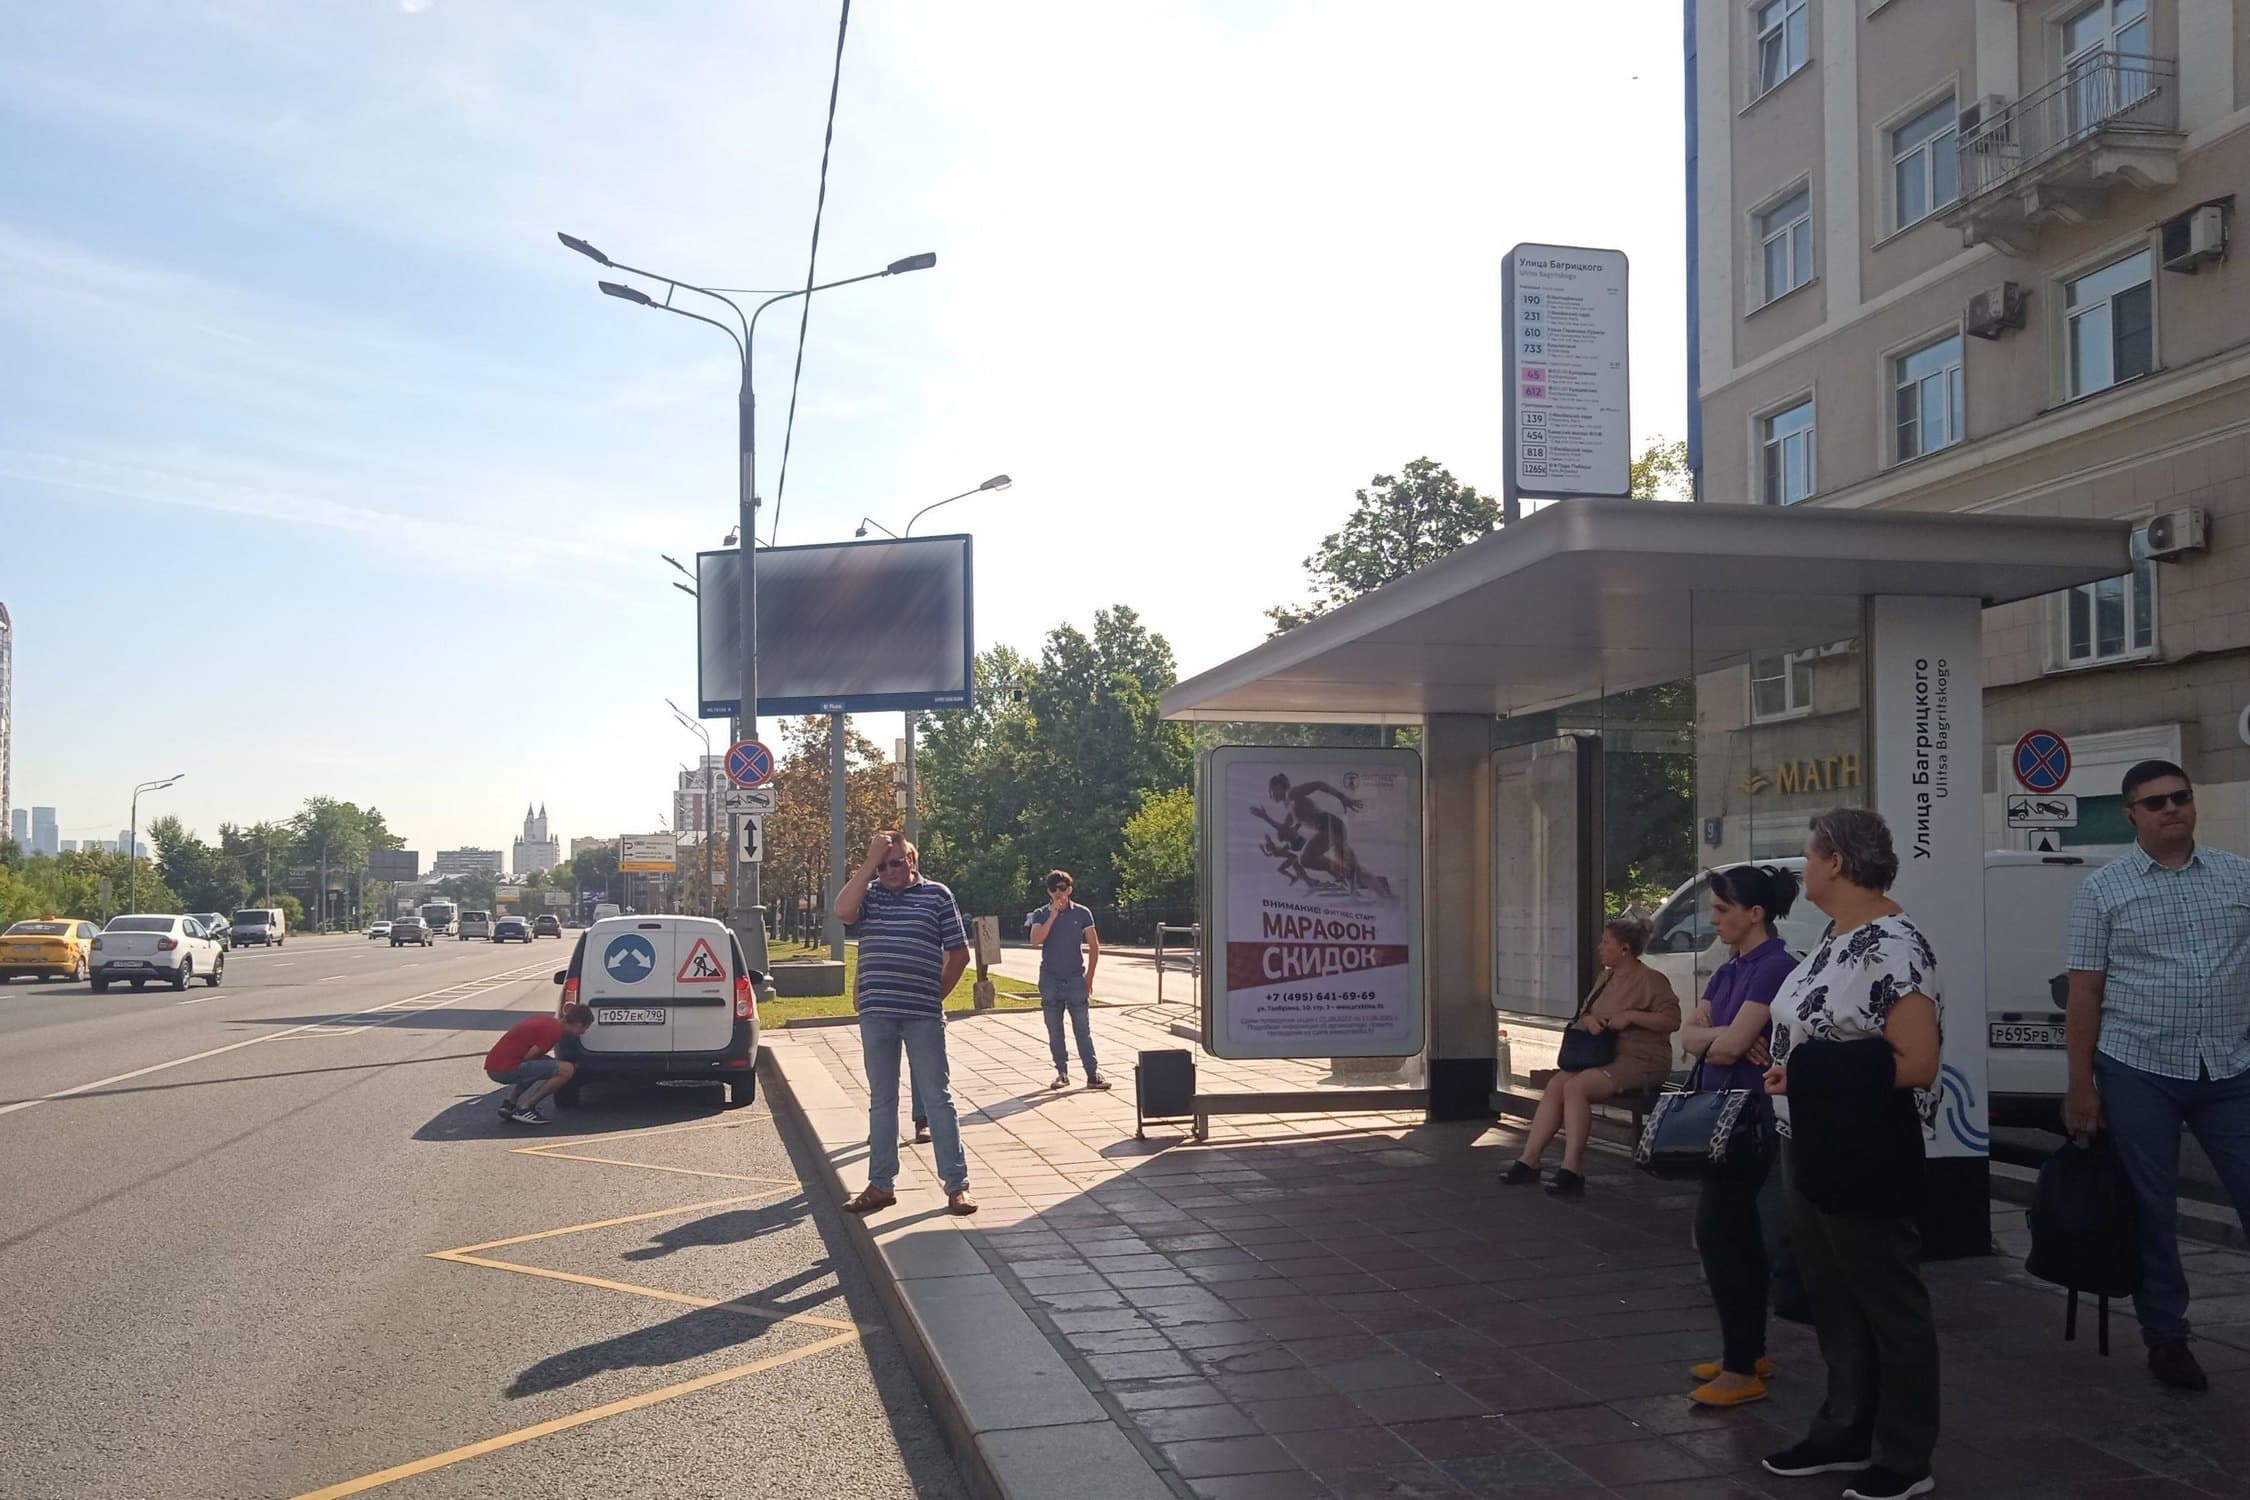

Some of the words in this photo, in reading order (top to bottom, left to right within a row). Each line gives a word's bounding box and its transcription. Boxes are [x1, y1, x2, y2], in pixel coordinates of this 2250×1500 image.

[1519, 258, 1548, 268] Улица
[1550, 260, 1603, 272] Багрицкого
[1523, 295, 1541, 305] 190
[1524, 311, 1541, 321] 231
[1524, 328, 1541, 338] 610
[1523, 344, 1542, 354] 733
[1525, 387, 1542, 397] 612
[1527, 414, 1543, 423] 139
[1526, 431, 1543, 440] 454
[1527, 448, 1544, 457] 818
[1935, 658, 1950, 750] Bagritskogo
[1912, 659, 1933, 786] Багрицкого
[1935, 754, 1949, 798] Ulitsa
[1913, 791, 1932, 859] Улица
[1706, 824, 1714, 838] 9
[1262, 911, 1376, 941] МАРАФОН
[1262, 946, 1377, 980] СКИДОК
[1266, 992, 1280, 1001] +7
[1283, 992, 1313, 1002] (495)
[1316, 991, 1376, 1001] 641-69-69
[603, 1010, 644, 1021] Т057ЕК
[1995, 1026, 2049, 1043] Р695РВ
